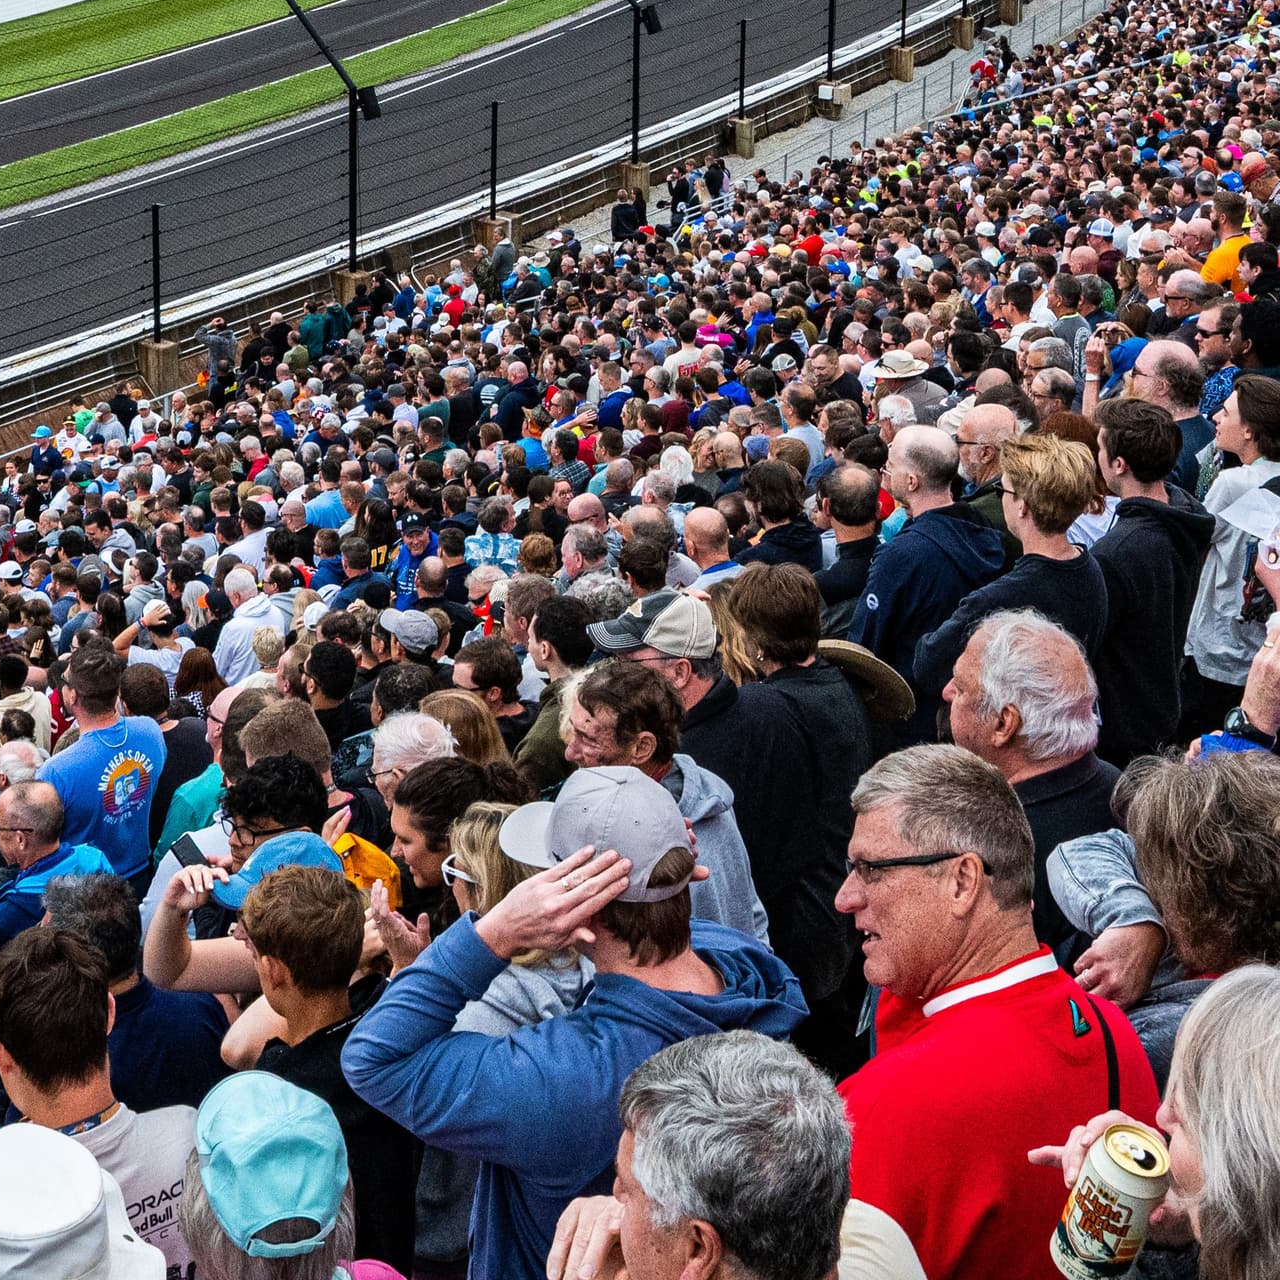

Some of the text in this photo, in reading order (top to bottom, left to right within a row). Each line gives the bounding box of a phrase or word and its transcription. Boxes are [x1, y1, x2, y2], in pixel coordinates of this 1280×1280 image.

[370, 545, 388, 568] 17
[97, 749, 155, 791] MOTHER'S OPEN
[126, 1178, 185, 1220] ORAC
[150, 1205, 173, 1228] Bull
[1075, 1188, 1132, 1237] Hearted
[1085, 1186, 1123, 1223] Light
[1078, 1213, 1104, 1243] IPA
